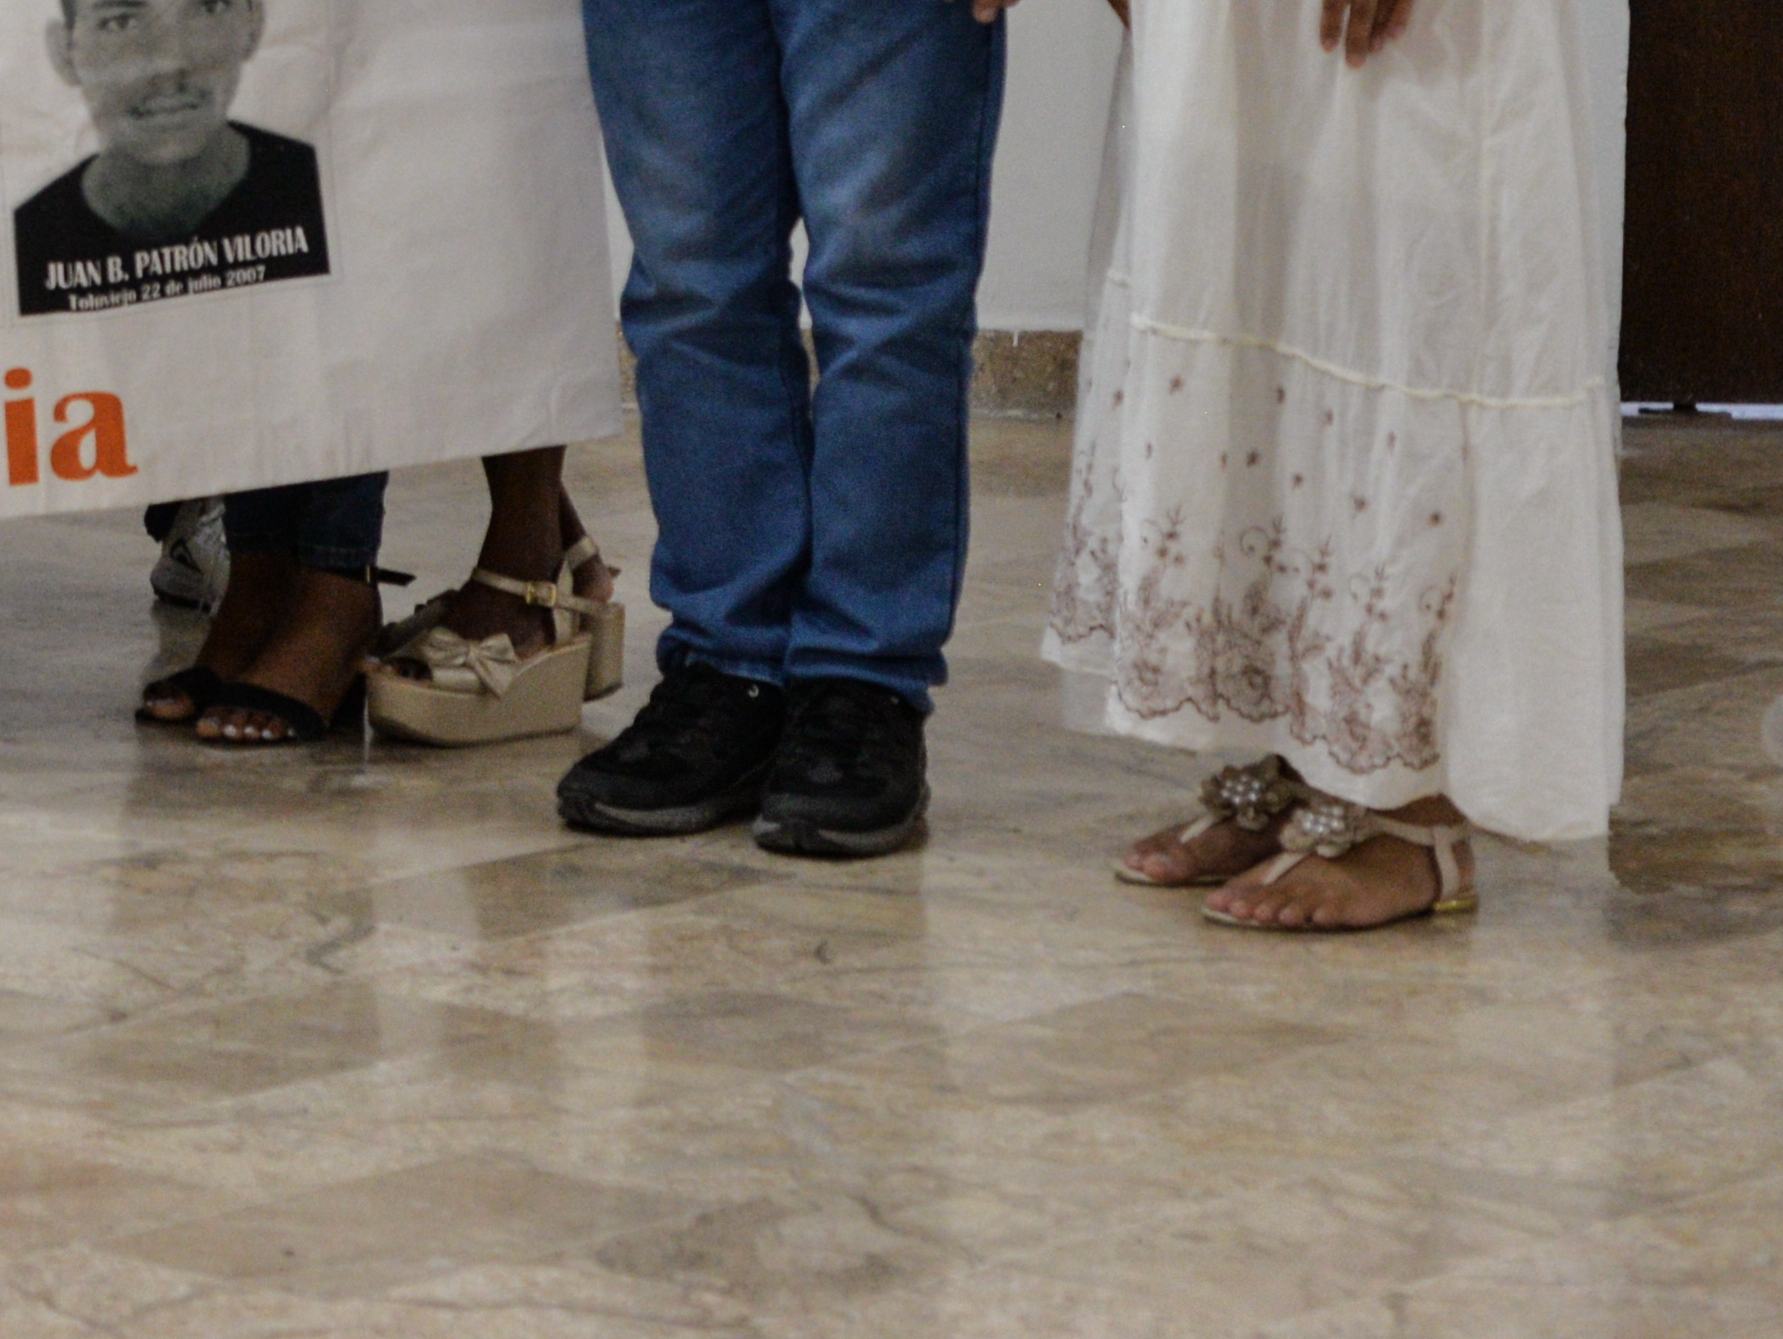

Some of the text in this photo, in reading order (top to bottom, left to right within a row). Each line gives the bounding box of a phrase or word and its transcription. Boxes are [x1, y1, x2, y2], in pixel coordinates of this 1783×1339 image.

[45, 226, 309, 291] JUAN B. PATRÓN VILORIA
[68, 265, 267, 312] Toluviejo 22 de julio 2007
